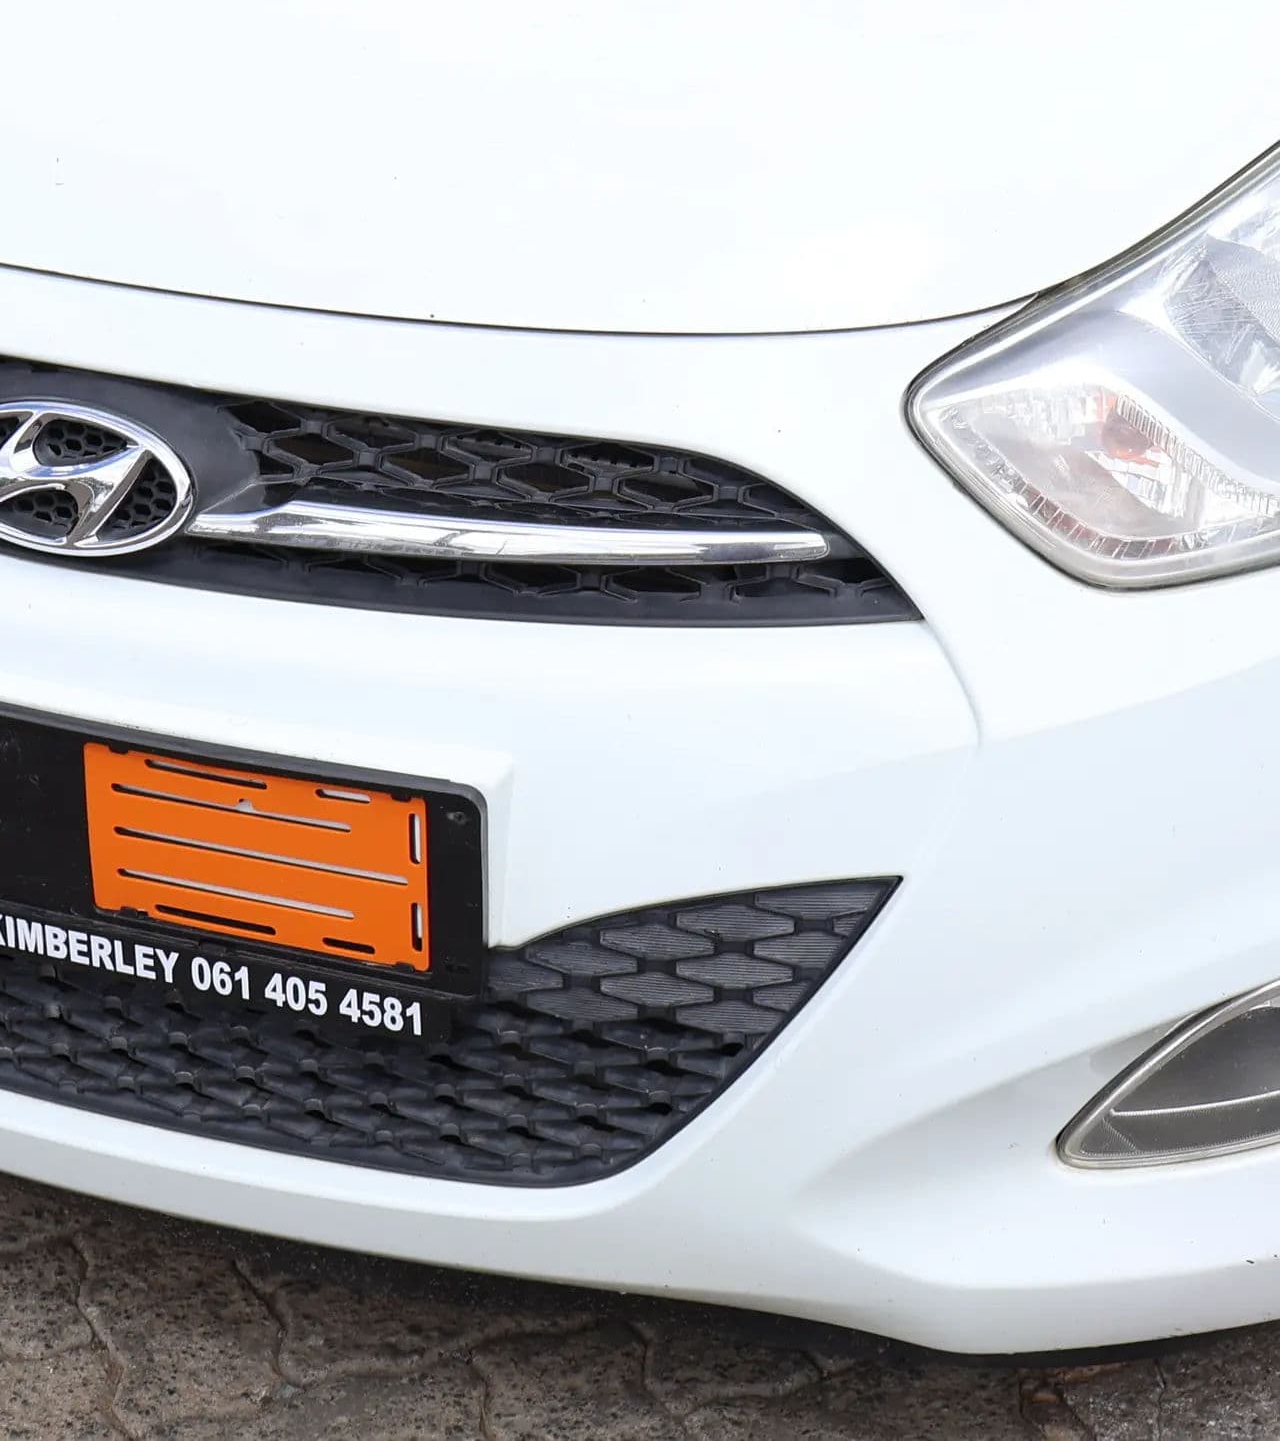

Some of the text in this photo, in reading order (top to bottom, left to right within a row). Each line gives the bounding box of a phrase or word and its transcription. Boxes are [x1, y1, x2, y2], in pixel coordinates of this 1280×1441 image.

[190, 956, 251, 1001] 061
[263, 972, 329, 1016] 405
[338, 987, 424, 1036] 4581
